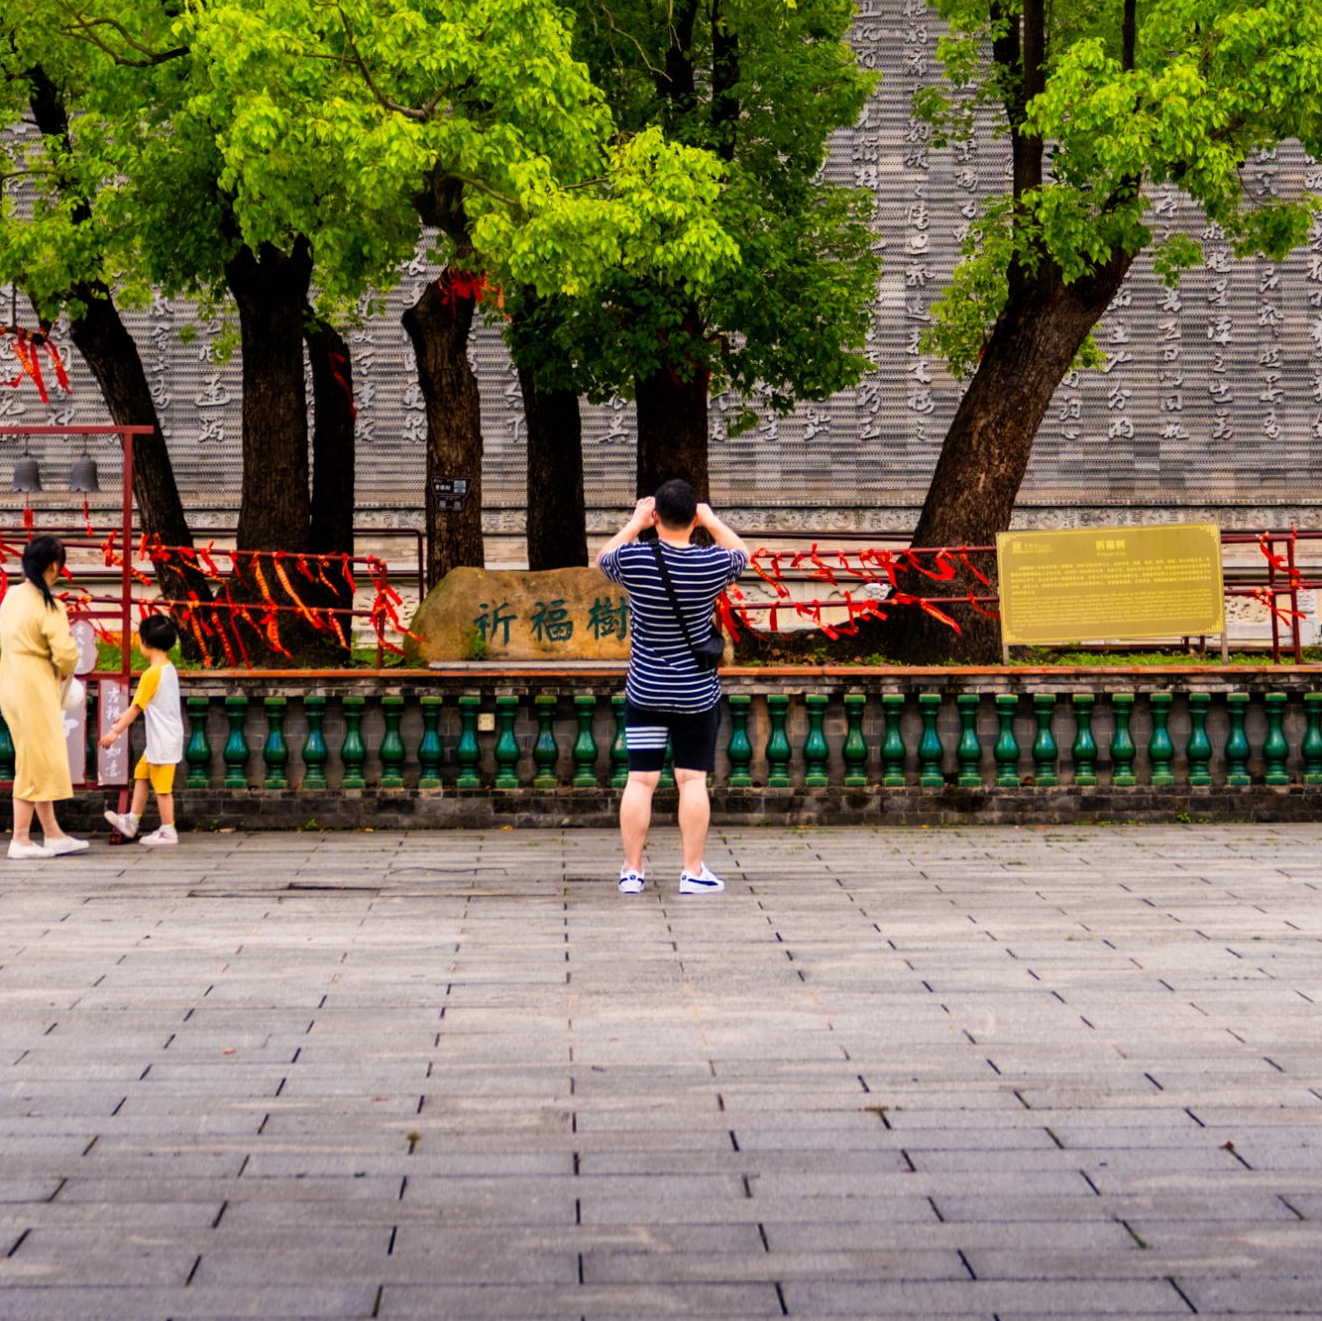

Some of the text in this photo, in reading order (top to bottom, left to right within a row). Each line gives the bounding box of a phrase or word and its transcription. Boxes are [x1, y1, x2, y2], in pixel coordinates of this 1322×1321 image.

[1095, 539, 1126, 551] 祈福树
[473, 597, 630, 646] 祈福樹
[104, 687, 122, 778] 吉祥如意
